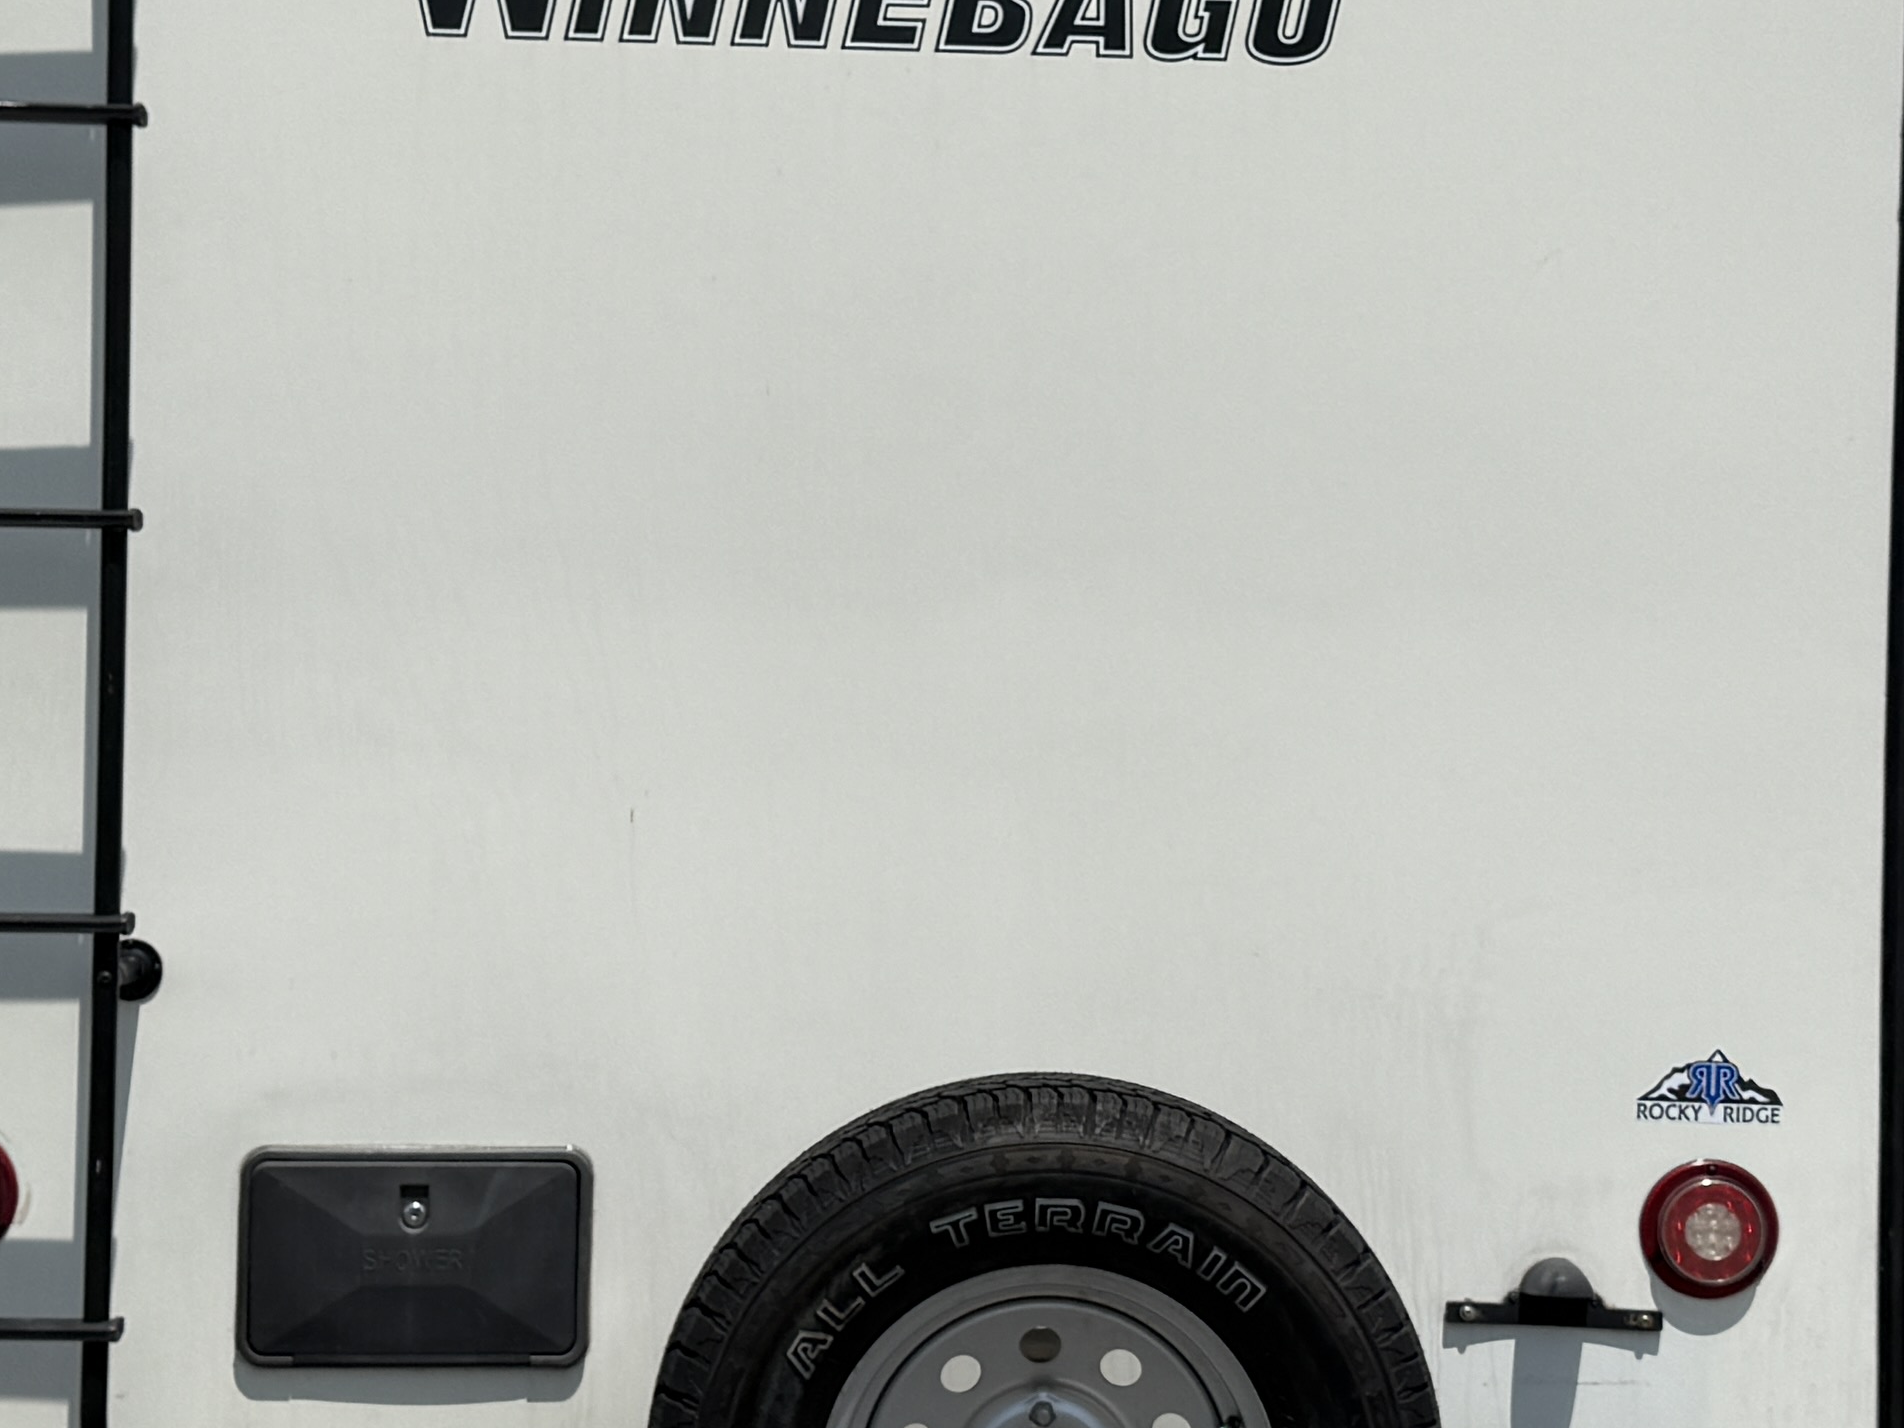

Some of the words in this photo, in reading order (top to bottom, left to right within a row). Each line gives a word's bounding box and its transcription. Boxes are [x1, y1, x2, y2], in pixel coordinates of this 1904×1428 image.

[1636, 1102, 1702, 1122] ROCKY
[1723, 1105, 1781, 1124] RIDGE
[786, 1262, 905, 1381] ALL
[929, 1197, 1268, 1314] TERRAIN
